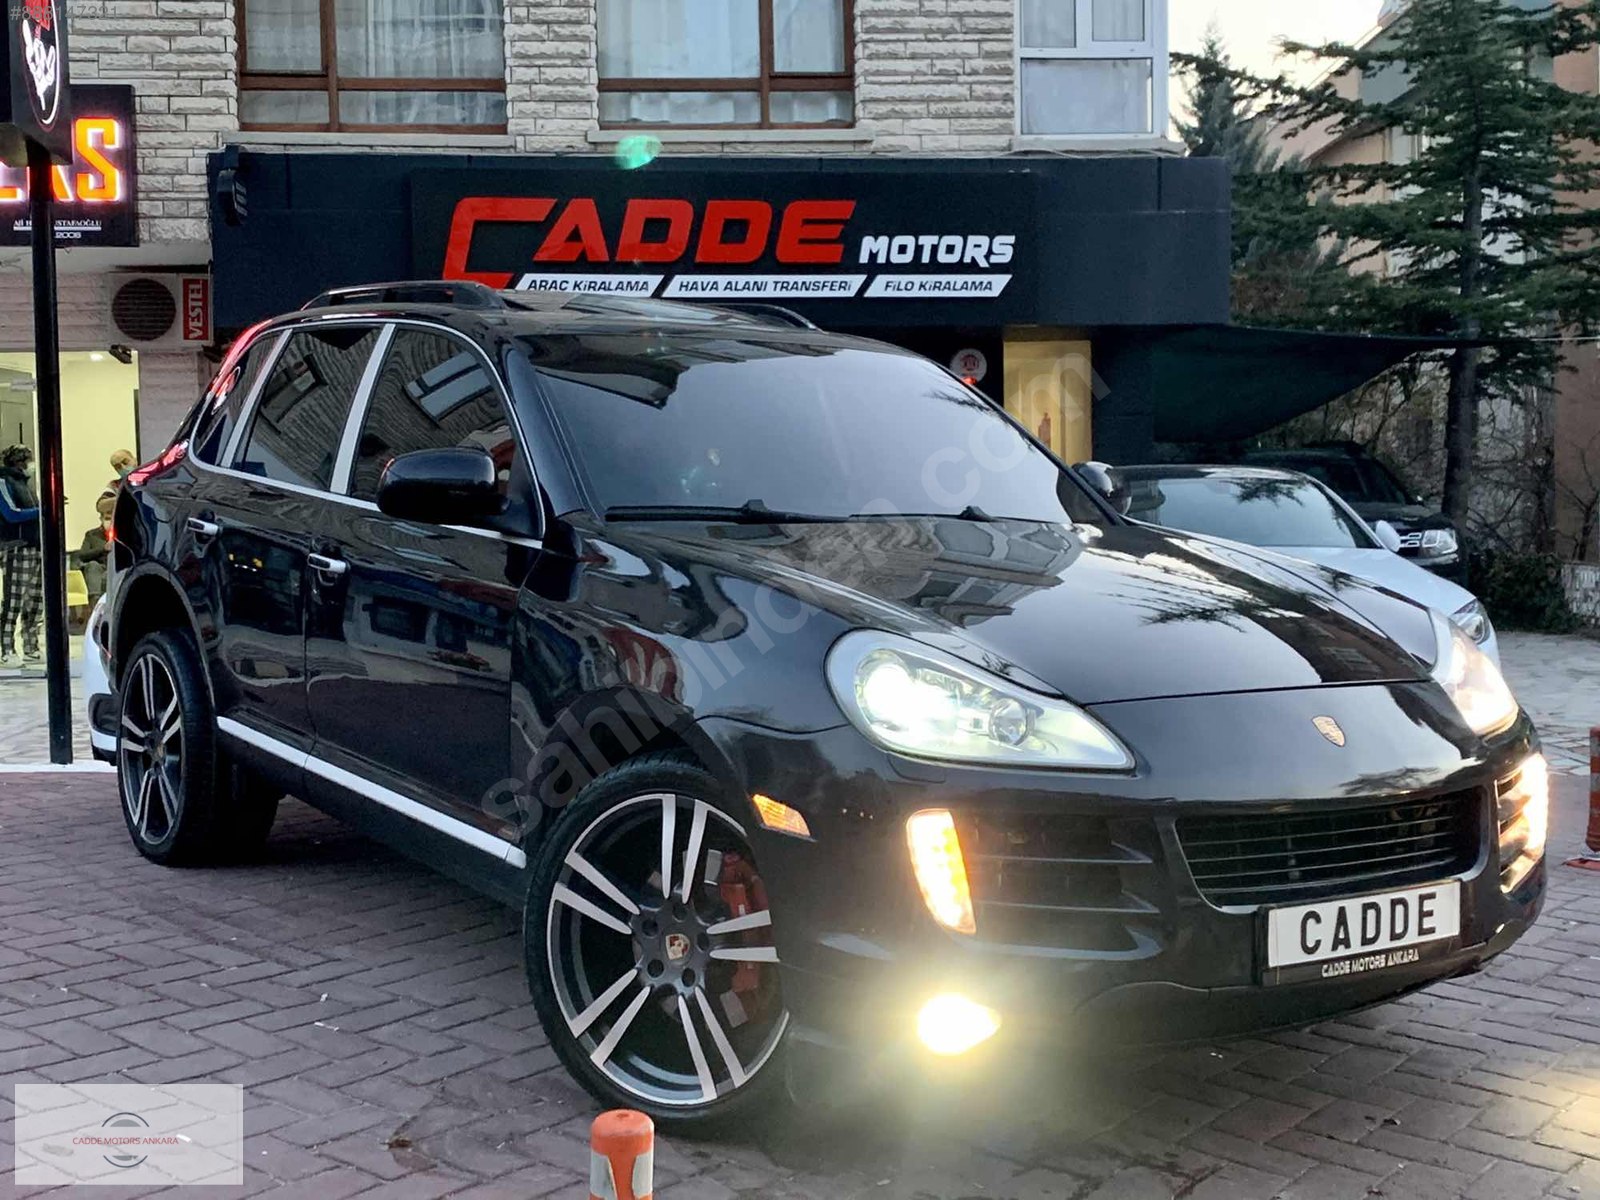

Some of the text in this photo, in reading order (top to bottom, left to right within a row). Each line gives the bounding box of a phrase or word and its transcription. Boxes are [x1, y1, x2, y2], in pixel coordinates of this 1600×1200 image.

[443, 197, 1015, 288] CADDE MOTORS
[188, 280, 204, 339] VESTEL
[679, 280, 718, 292] HAVA
[724, 281, 768, 292] ALANI
[1300, 892, 1437, 955] CADDE
[1321, 948, 1420, 978] CADDE MOTORS ANKARA
